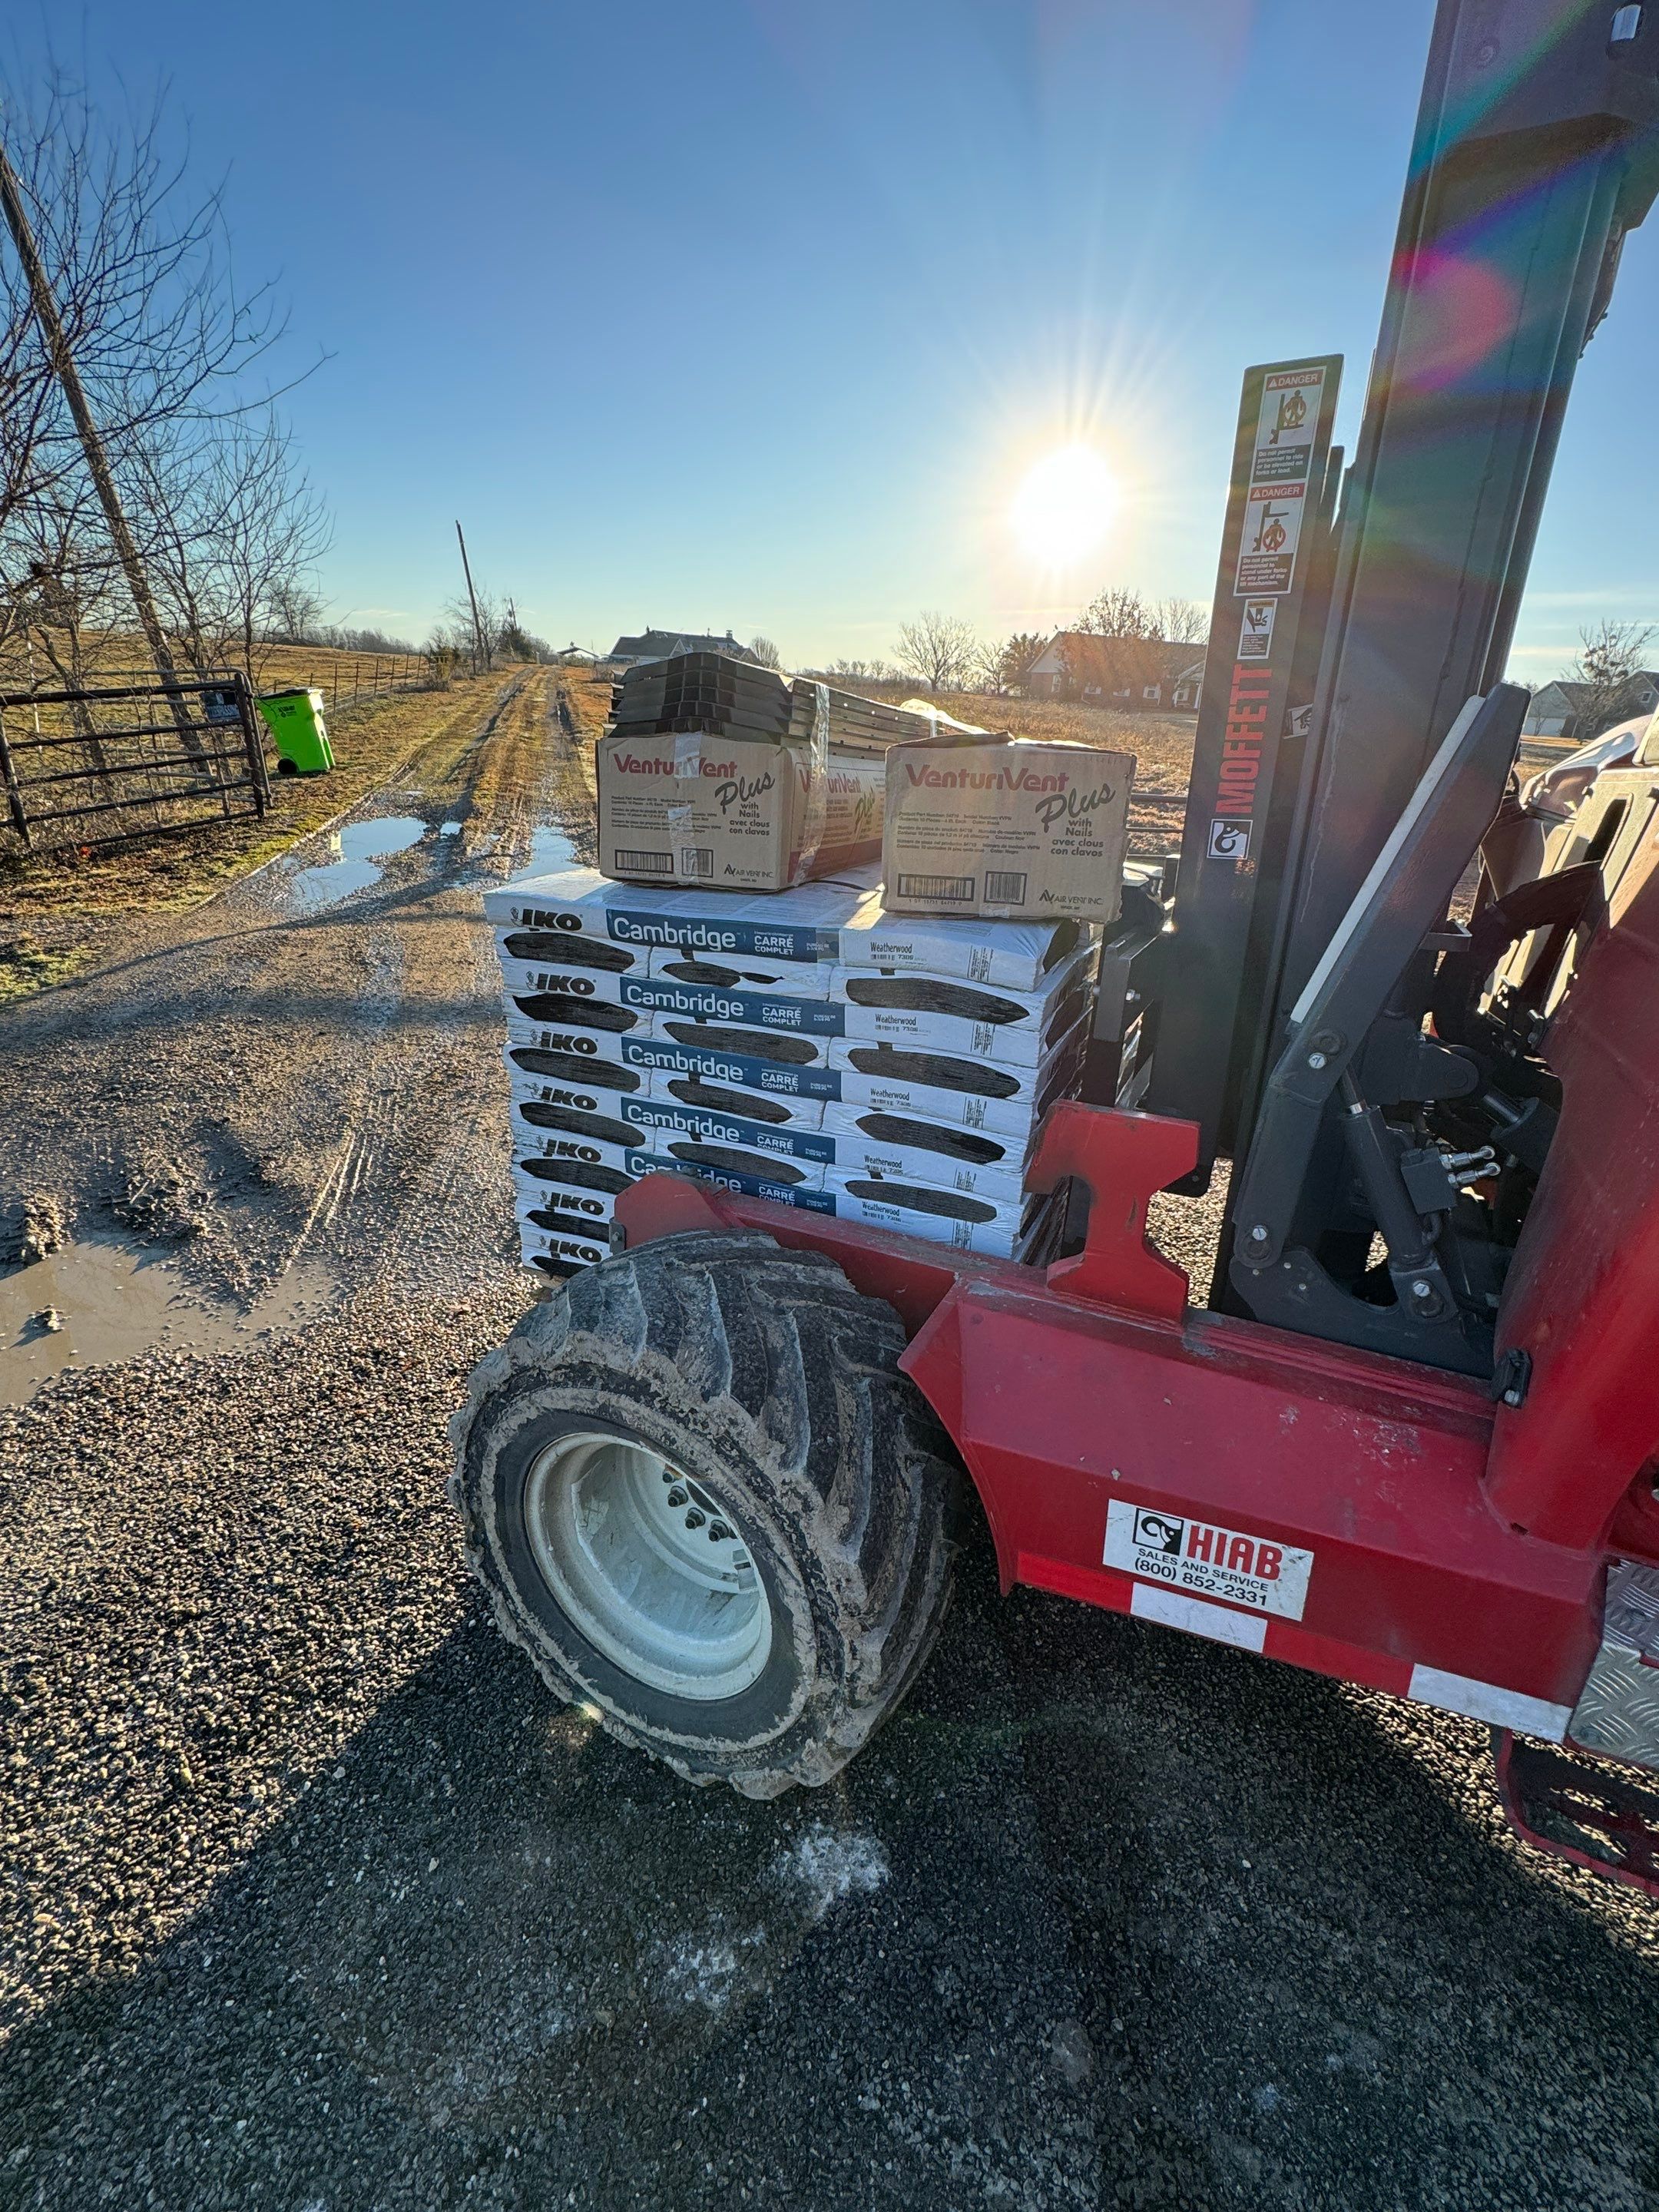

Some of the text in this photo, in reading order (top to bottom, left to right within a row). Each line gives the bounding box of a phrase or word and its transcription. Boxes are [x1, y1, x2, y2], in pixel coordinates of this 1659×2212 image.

[1277, 373, 1318, 387] DANGER
[1261, 486, 1300, 498] DANGER
[1215, 664, 1272, 813] MOFFETT
[905, 763, 1070, 793] VenturiVent
[715, 771, 776, 815] Plus
[740, 802, 759, 810] with
[1035, 783, 1116, 833] Plus
[739, 810, 760, 819] Nails
[750, 819, 770, 828] clous
[1068, 818, 1092, 827] with
[745, 826, 770, 836] clavos
[1065, 827, 1093, 836] Nails
[1051, 838, 1104, 848] avec clous
[1069, 847, 1103, 857] clavos
[1068, 896, 1087, 904] VENT
[521, 909, 583, 932] IKO
[614, 917, 736, 951] Cambridge
[754, 935, 793, 948] CARRÉ
[870, 942, 912, 953] Weatherwood
[754, 945, 793, 955] COMPLET
[537, 973, 595, 995] IKO
[627, 985, 744, 1018] Cambridge
[762, 1006, 802, 1019] CARRÉ
[876, 1014, 916, 1025] Weatherwood
[763, 1016, 802, 1026] COMPLET
[540, 1031, 598, 1055] IKO
[628, 1045, 743, 1081] Cambridge
[761, 1072, 798, 1086] CARRÉ
[761, 1081, 799, 1092] COMPLET
[541, 1085, 598, 1111] IKO
[870, 1088, 909, 1101] Weatherwood
[628, 1104, 740, 1141] Cambridge
[543, 1138, 601, 1162] IKO
[757, 1136, 793, 1150] CARRÉ
[864, 1154, 902, 1168] Weatherwood
[759, 1186, 795, 1201] CARRÉ
[545, 1192, 604, 1216] IKO
[862, 1201, 899, 1216] Weatherwood
[549, 1239, 601, 1262] IKO
[1187, 1524, 1283, 1581] HIAB
[1138, 1548, 1269, 1592] SALES AND SERVICE
[1134, 1557, 1267, 1606] (800) 852-2331
